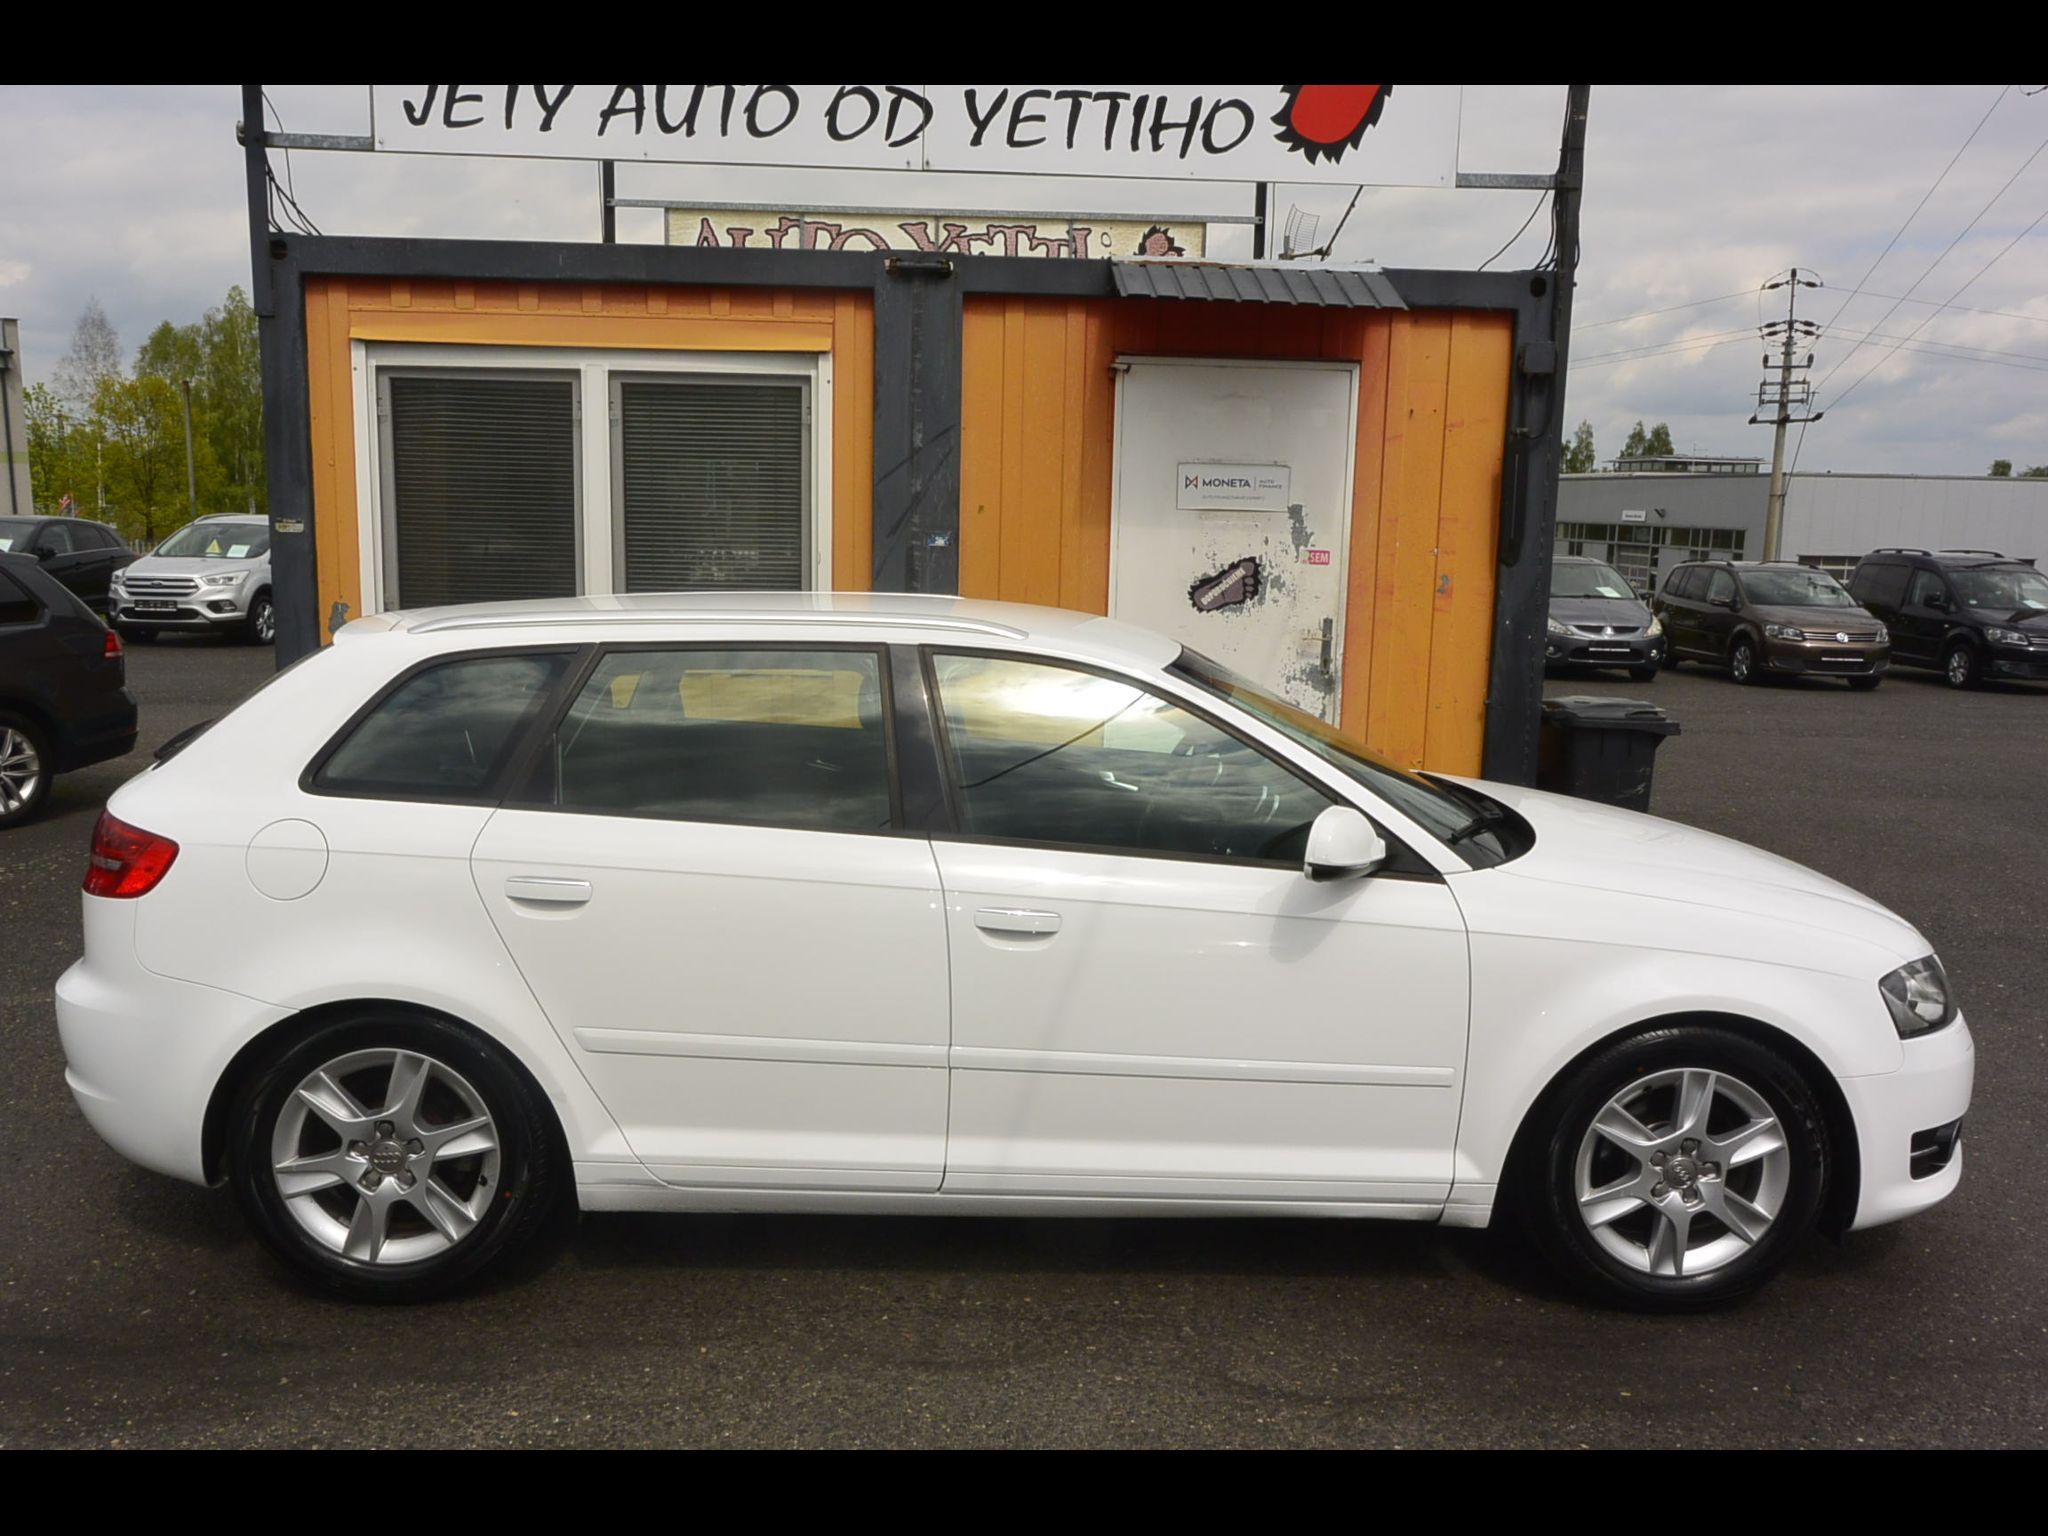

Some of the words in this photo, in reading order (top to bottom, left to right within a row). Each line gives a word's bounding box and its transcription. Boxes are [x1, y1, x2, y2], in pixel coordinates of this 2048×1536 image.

[597, 85, 800, 138] AUTO
[824, 85, 934, 148] OD
[963, 88, 1255, 160] YETTIHO
[1202, 478, 1252, 489] MONETA
